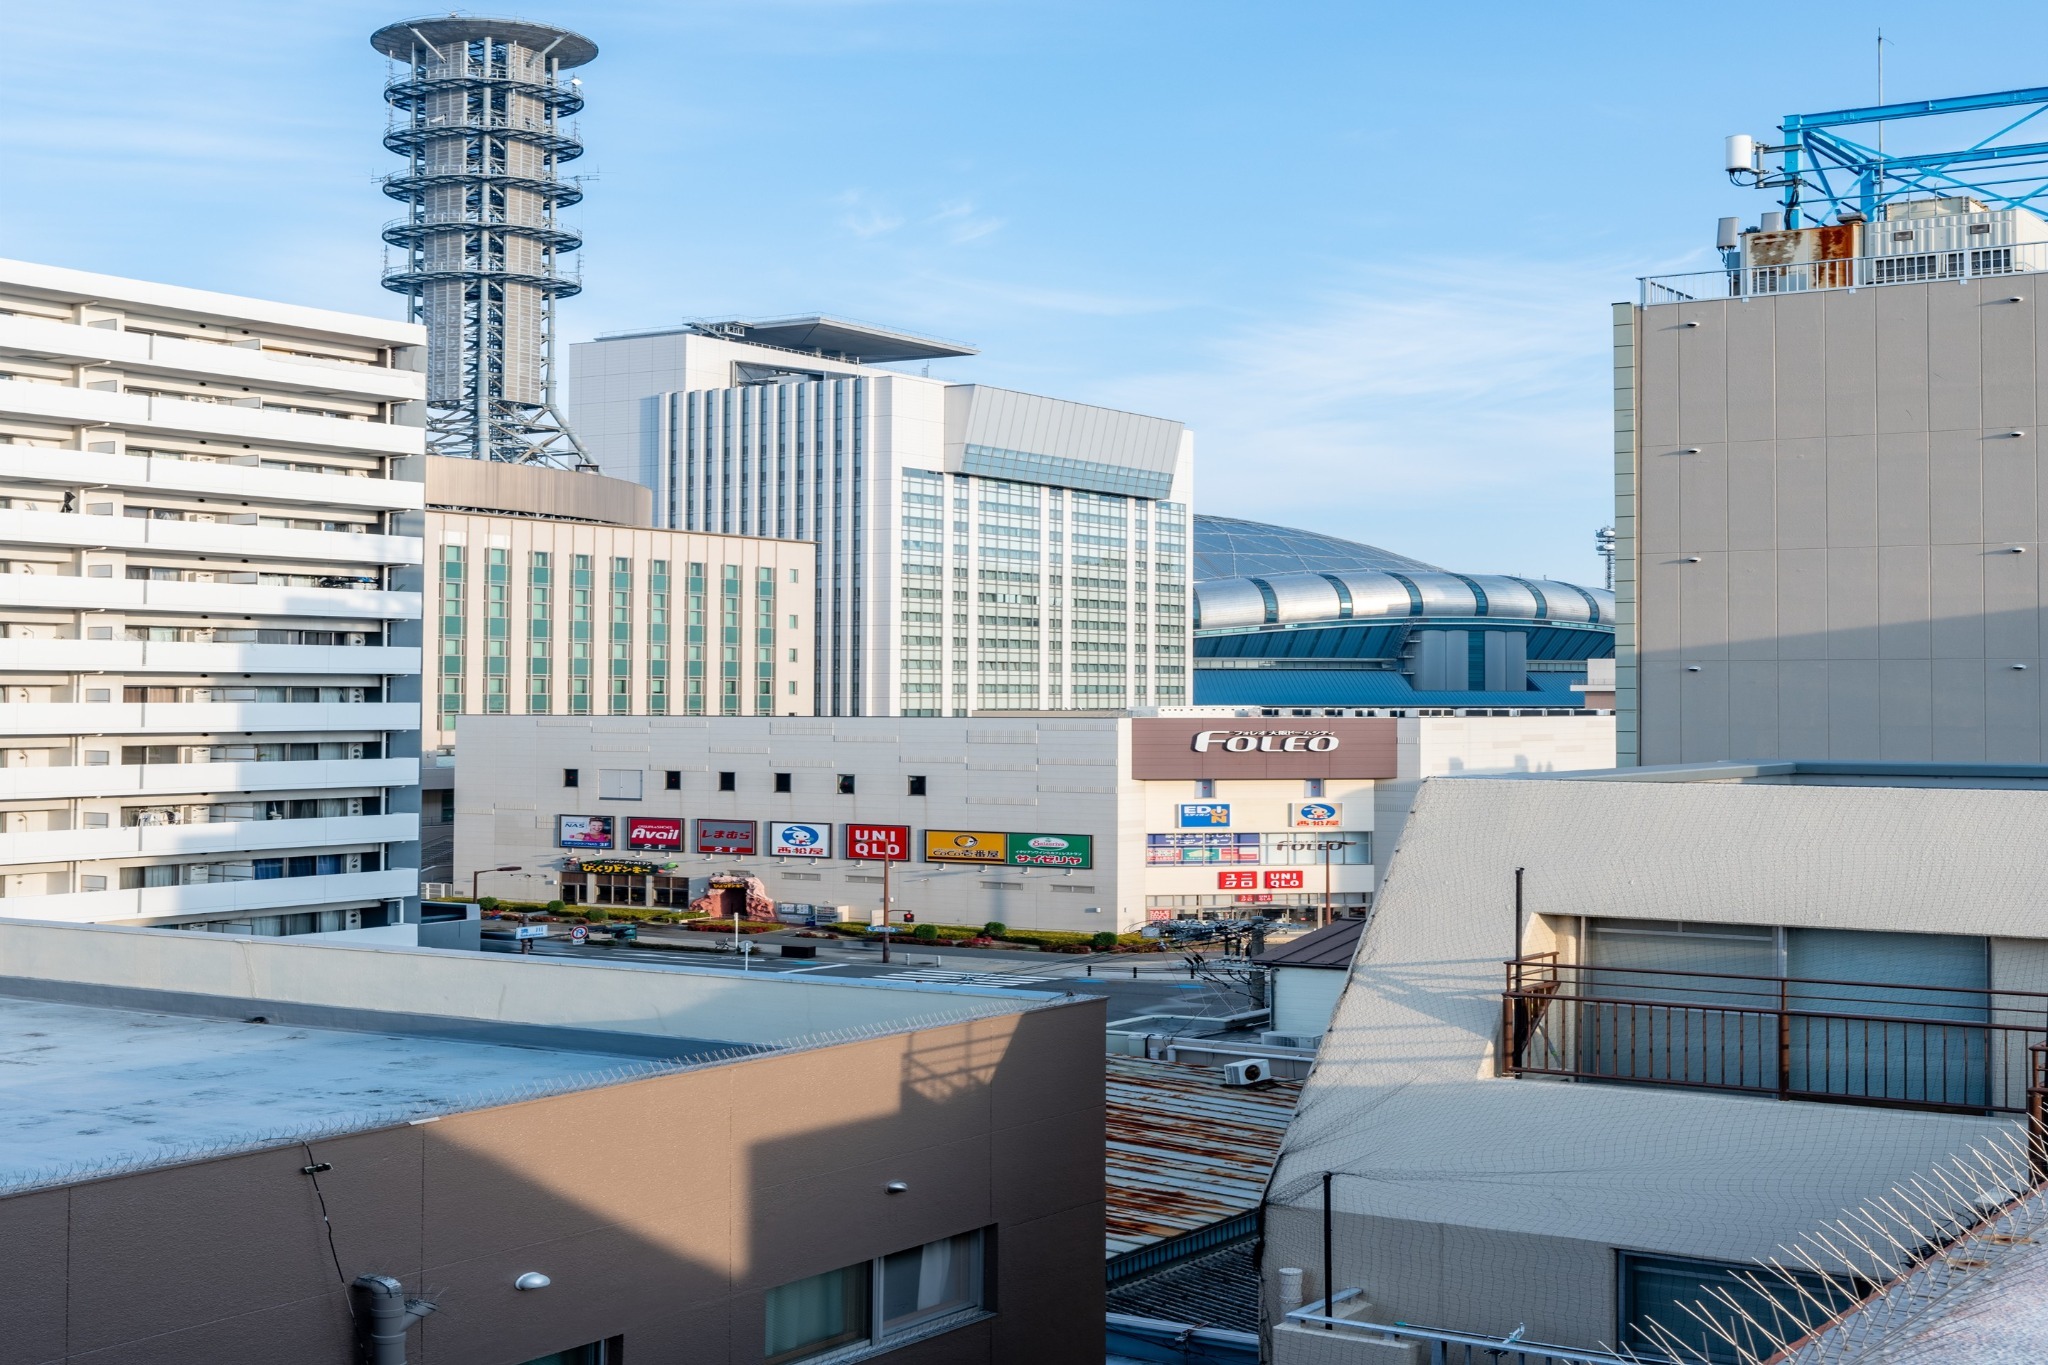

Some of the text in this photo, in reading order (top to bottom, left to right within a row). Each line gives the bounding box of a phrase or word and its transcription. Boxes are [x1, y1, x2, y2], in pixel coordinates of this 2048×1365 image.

[1194, 731, 1340, 753] FOLEO
[631, 828, 680, 840] Avail
[701, 829, 751, 840] しまむら
[777, 846, 824, 855] 西松屋
[1015, 854, 1082, 865] サイゼリヤ
[582, 863, 651, 874] びっくりドンキー
